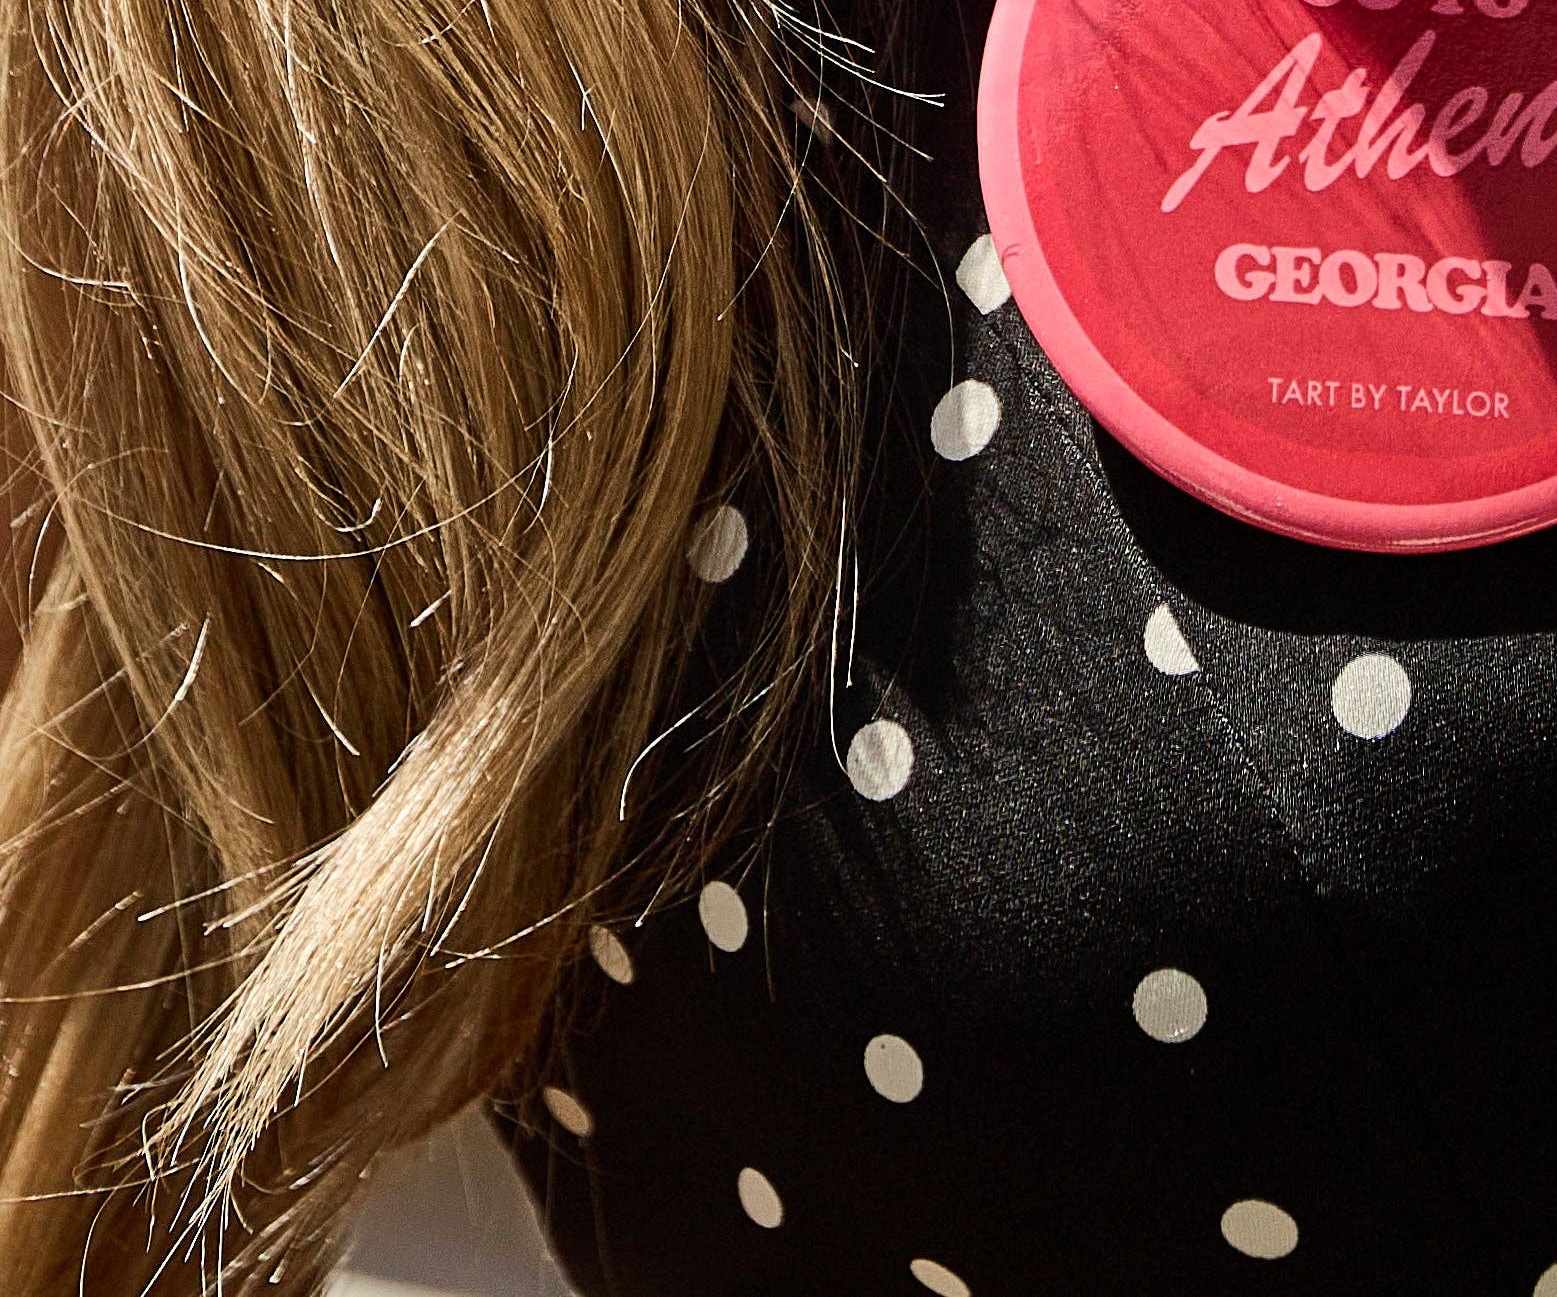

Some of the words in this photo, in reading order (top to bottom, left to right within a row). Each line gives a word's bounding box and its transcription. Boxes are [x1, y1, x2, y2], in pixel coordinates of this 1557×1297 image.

[1269, 378, 1339, 407] TART
[1351, 382, 1387, 410] BY
[1397, 385, 1510, 418] TAYLOR
